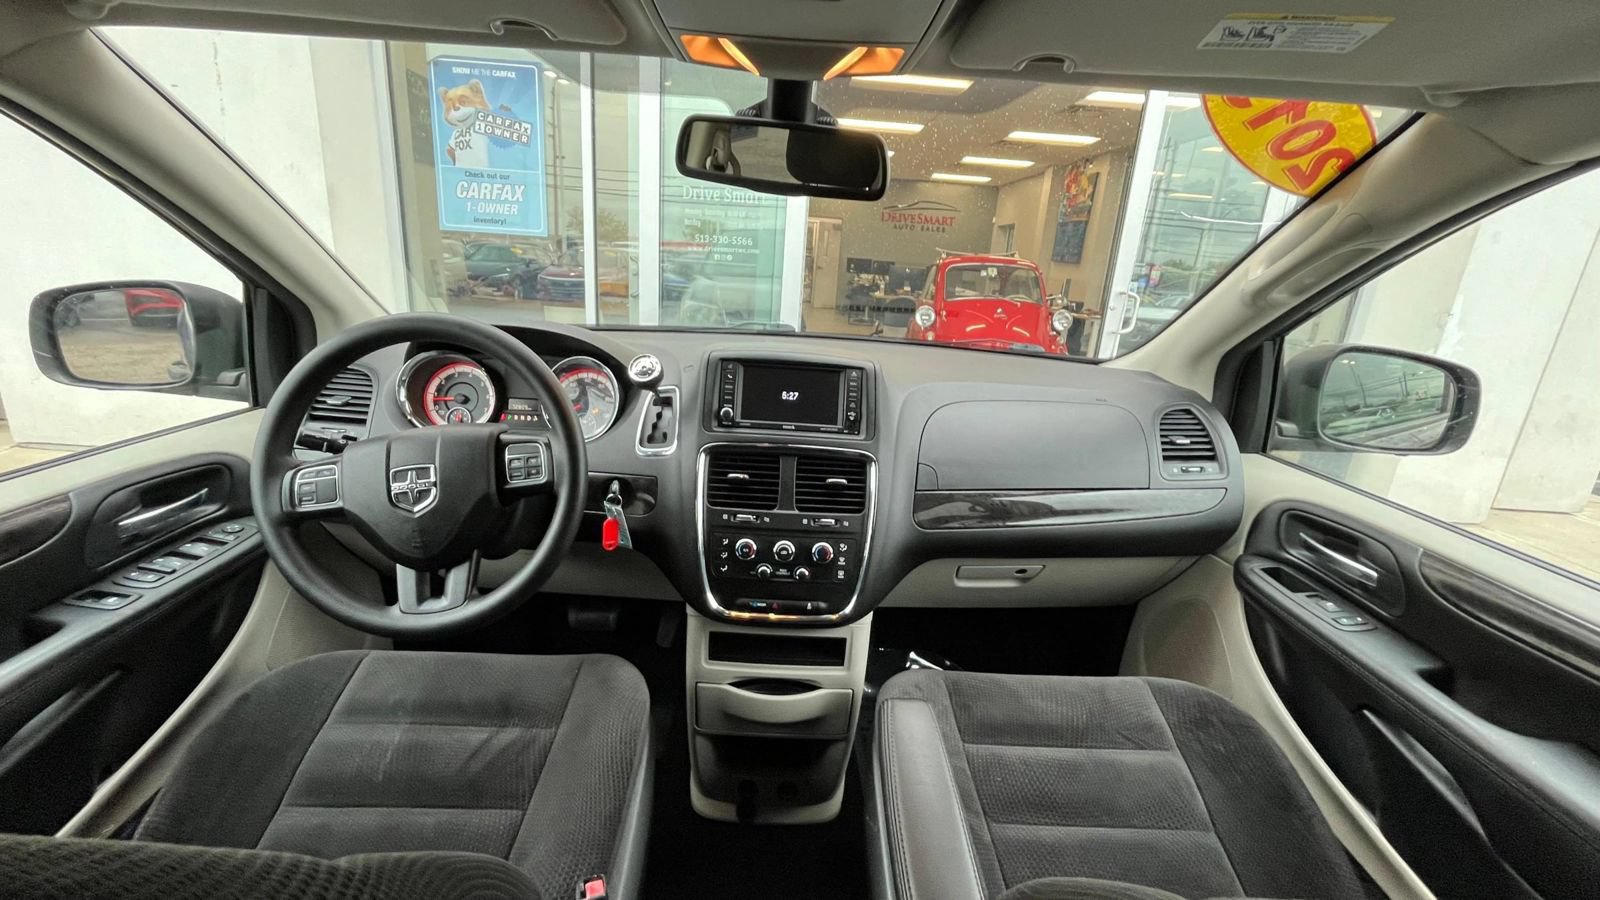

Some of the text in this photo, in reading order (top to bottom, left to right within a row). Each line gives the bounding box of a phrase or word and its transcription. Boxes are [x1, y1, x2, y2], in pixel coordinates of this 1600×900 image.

[492, 70, 516, 79] CARFAX
[477, 111, 530, 134] CARFAX
[455, 128, 472, 140] CAR
[455, 139, 472, 151] FOX
[464, 170, 484, 179] Check
[456, 180, 525, 202] CARFAX
[682, 185, 721, 201] Drive
[466, 201, 518, 215] 1-OWNER
[893, 223, 946, 233] AUTO SALES
